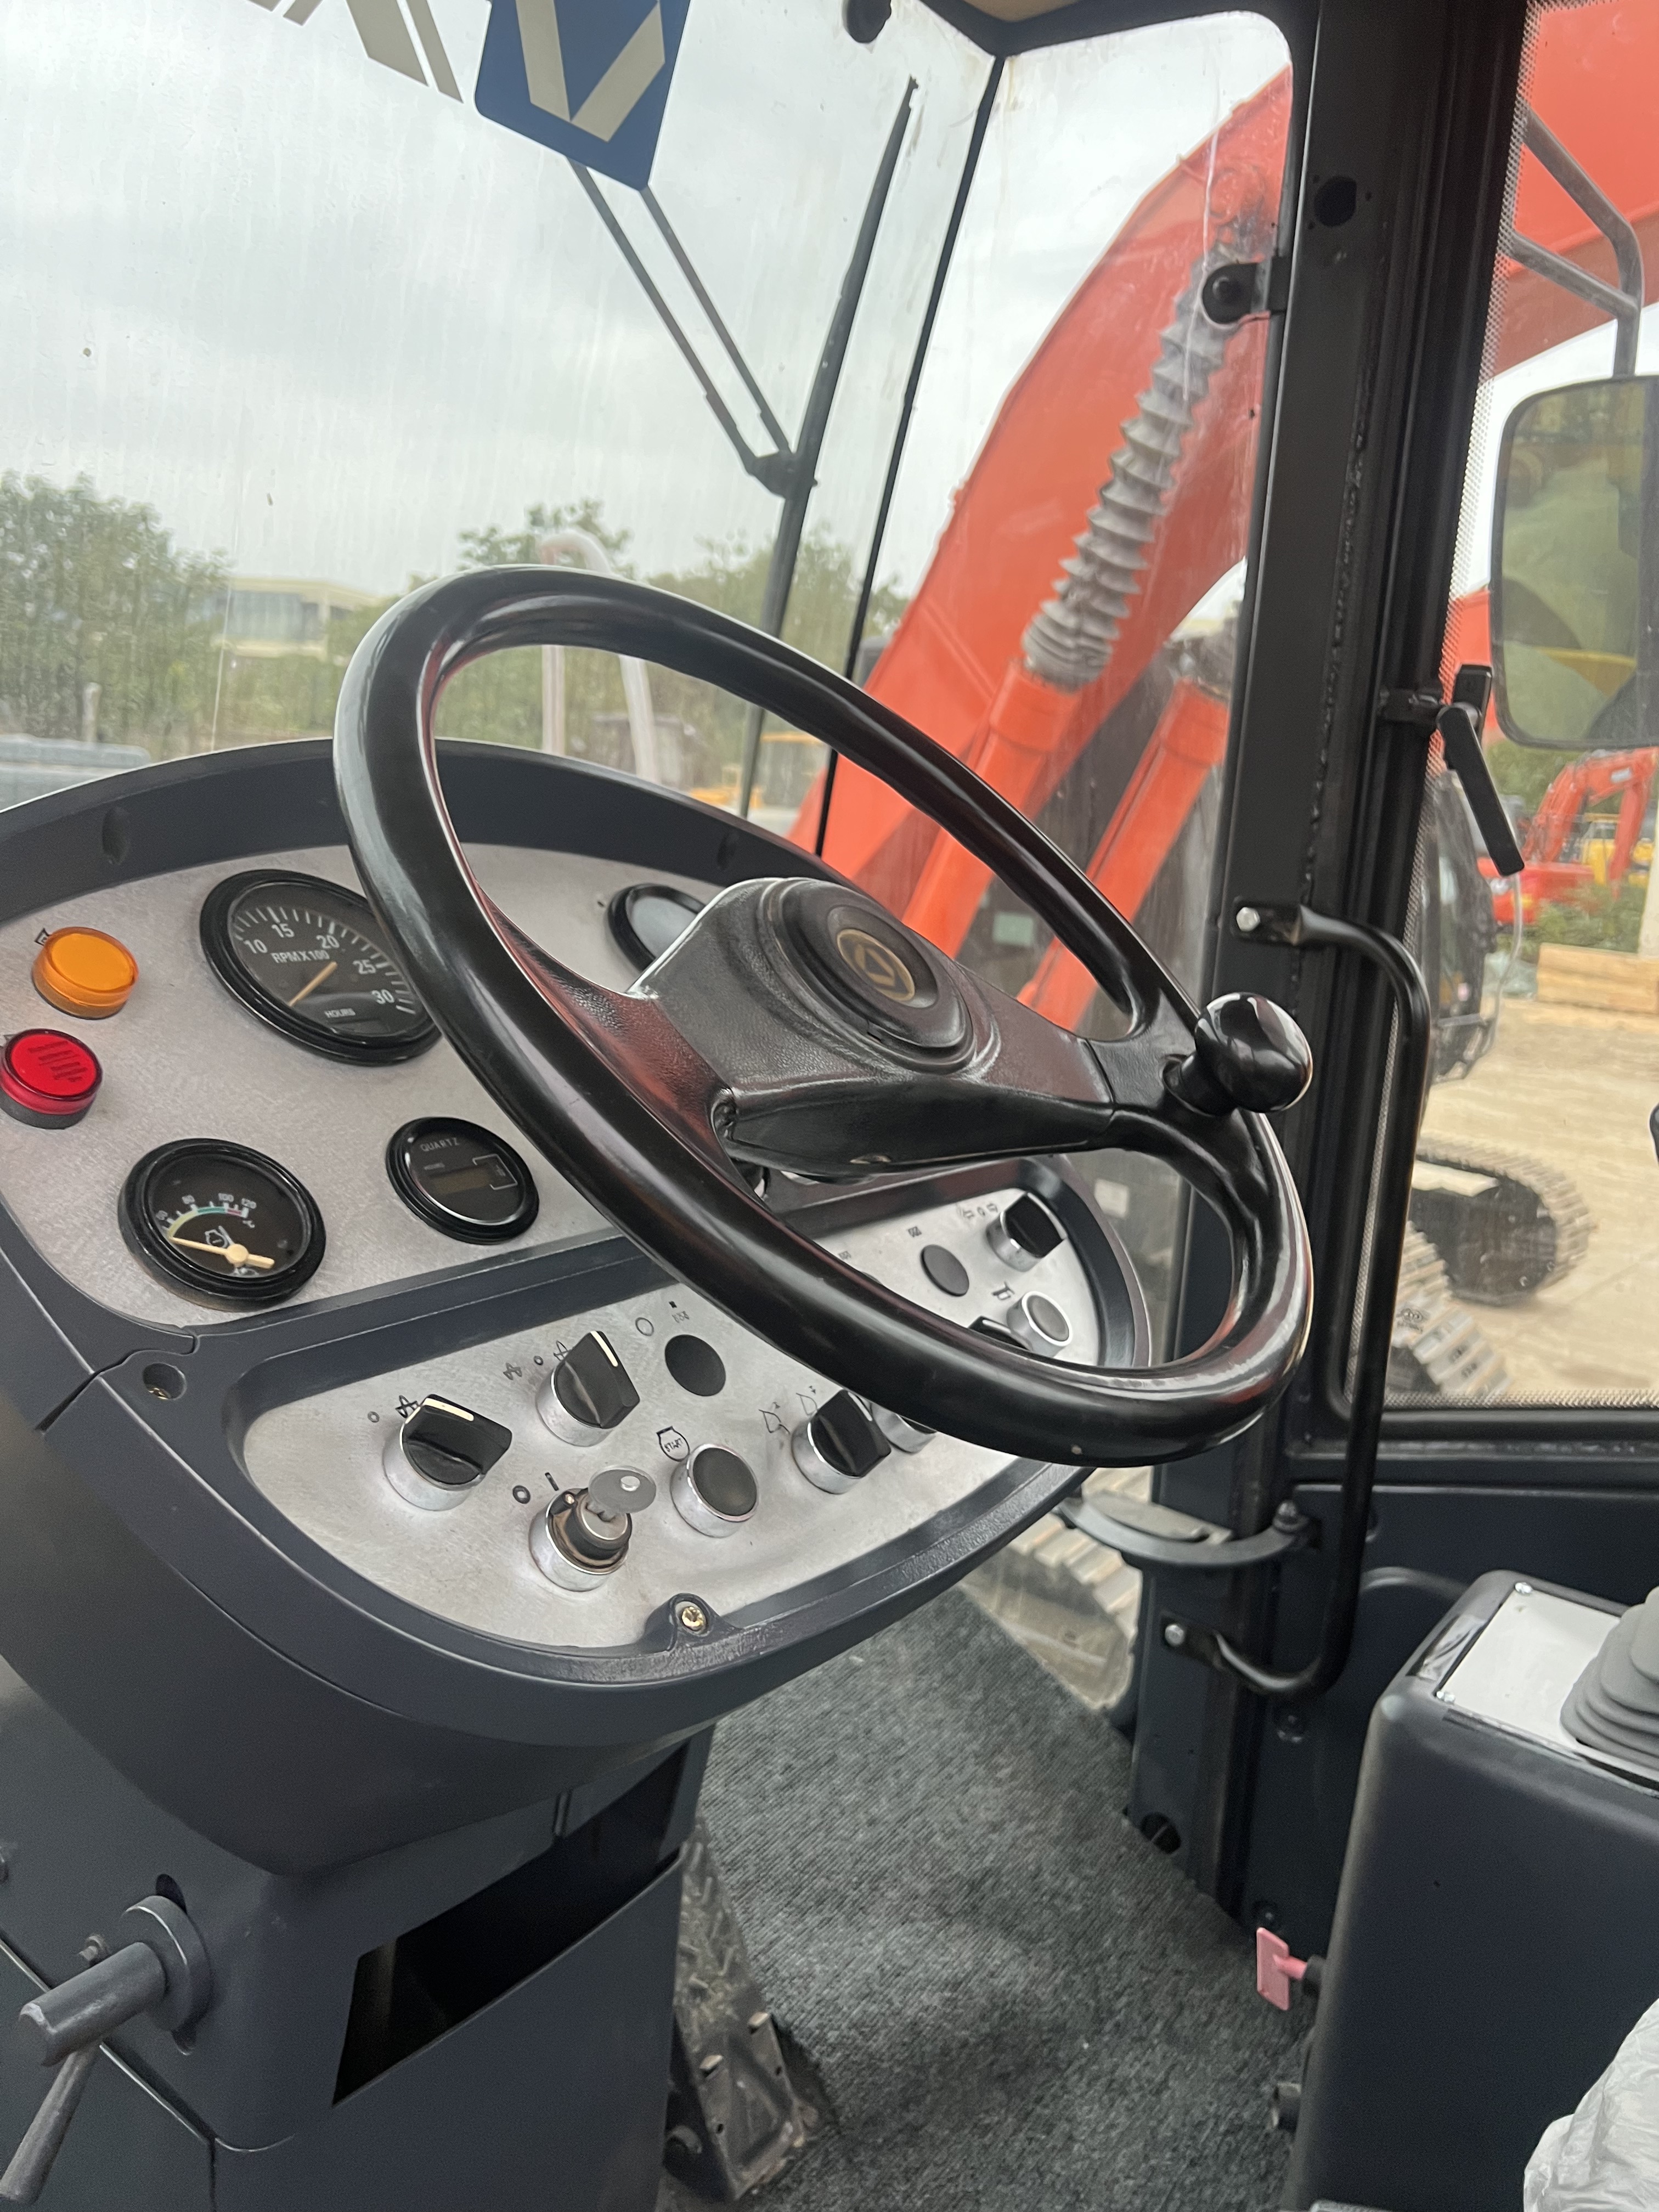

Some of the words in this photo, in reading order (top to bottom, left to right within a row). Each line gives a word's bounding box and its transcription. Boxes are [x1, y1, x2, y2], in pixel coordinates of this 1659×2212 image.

[271, 923, 295, 939] 15
[244, 938, 268, 954] 10
[316, 934, 340, 950] 20
[353, 959, 377, 975] 25
[371, 990, 395, 1005] 30
[420, 1137, 460, 1152] QUARTZ
[663, 1437, 684, 1453] START
